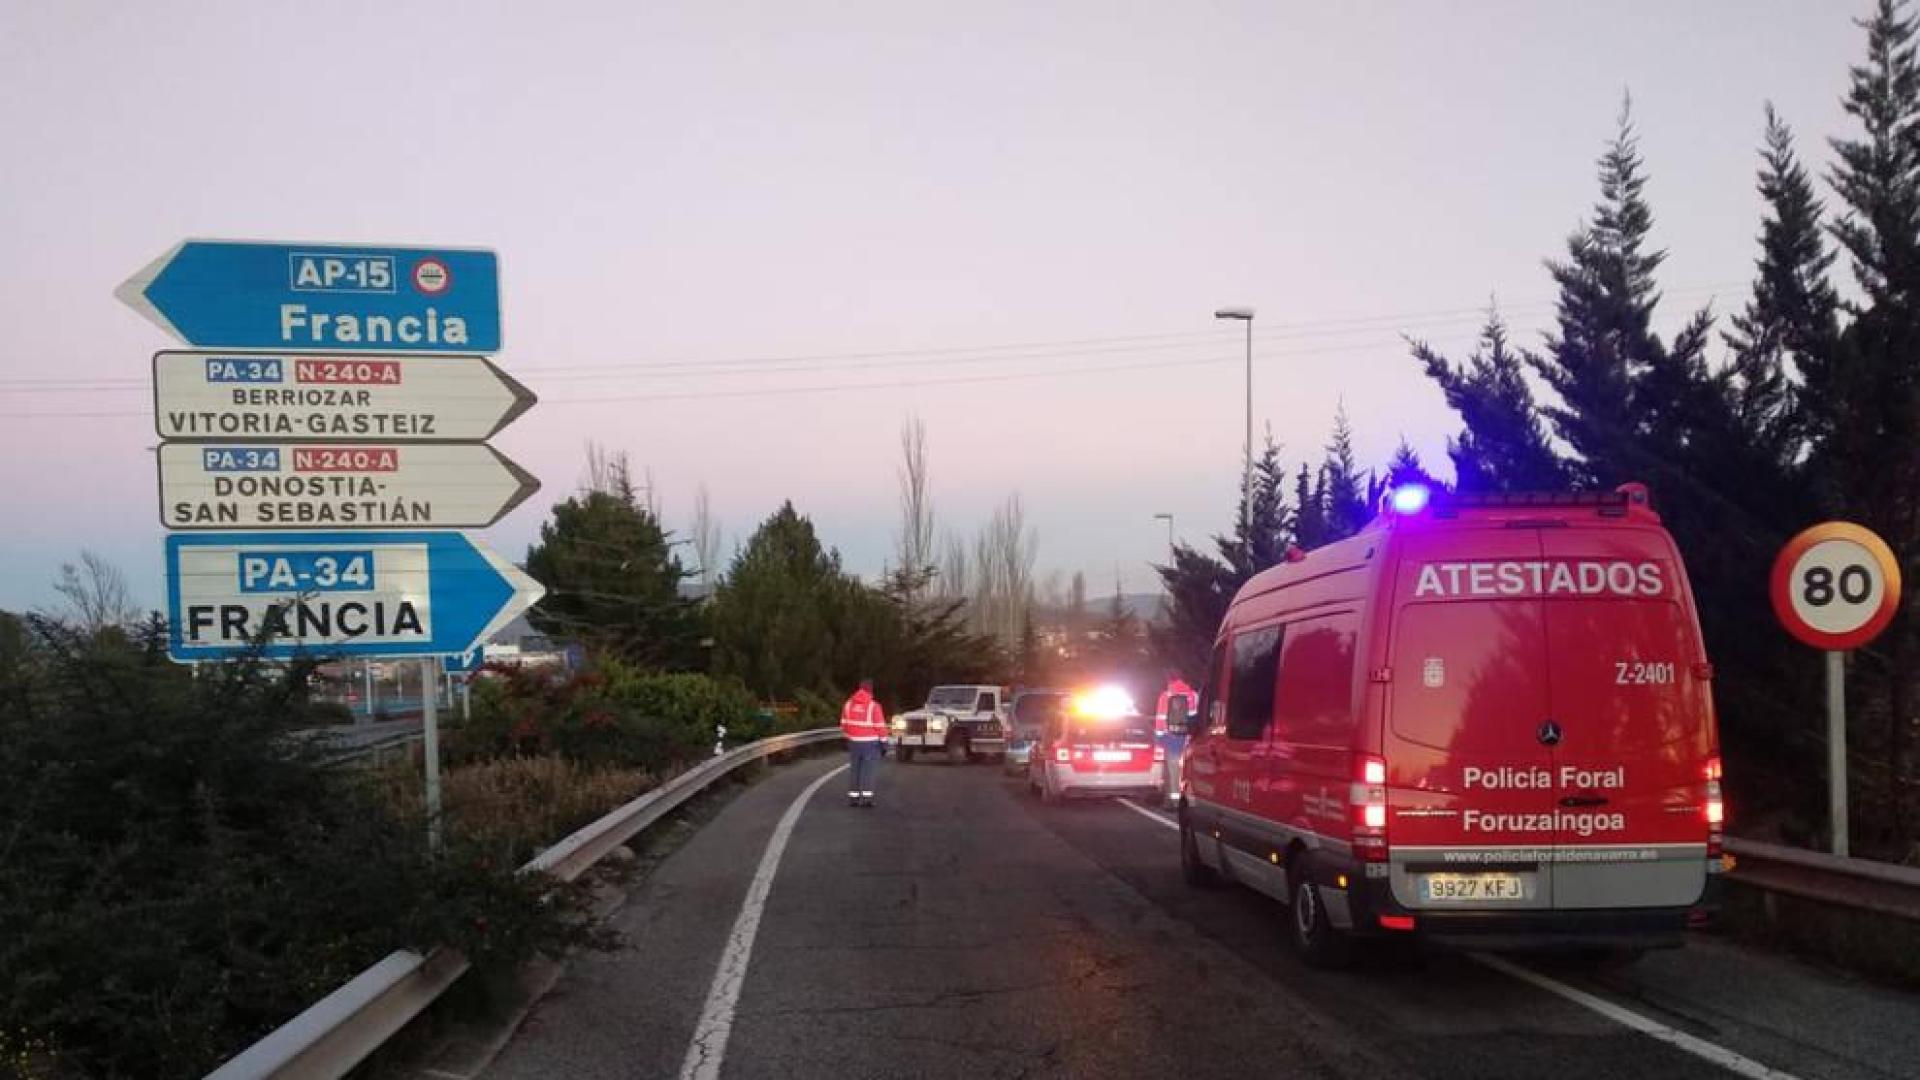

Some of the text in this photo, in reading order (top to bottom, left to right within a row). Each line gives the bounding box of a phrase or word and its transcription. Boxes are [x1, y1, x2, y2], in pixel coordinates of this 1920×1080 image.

[297, 260, 392, 288] AP-15
[280, 304, 469, 344] Francia
[208, 362, 398, 382] PA-34 N-240-A
[233, 390, 371, 406] BERRIOZAR
[169, 412, 436, 434] VITORIA-GASTEIZ
[206, 451, 395, 469] PA-34 N-240-A
[215, 476, 386, 497] DONOSTIA-
[174, 498, 431, 523] SAN SEBASTIÁN
[244, 557, 369, 588] PA-34
[1415, 562, 1663, 596] ATESTADOS
[1803, 564, 1872, 607] 80
[188, 602, 424, 641] FRANCIA
[1615, 662, 1675, 684] Z-2401
[1463, 766, 1624, 788] Policía Foral
[1463, 810, 1624, 836] Foruzaingoa
[1484, 879, 1521, 897] KFJ
